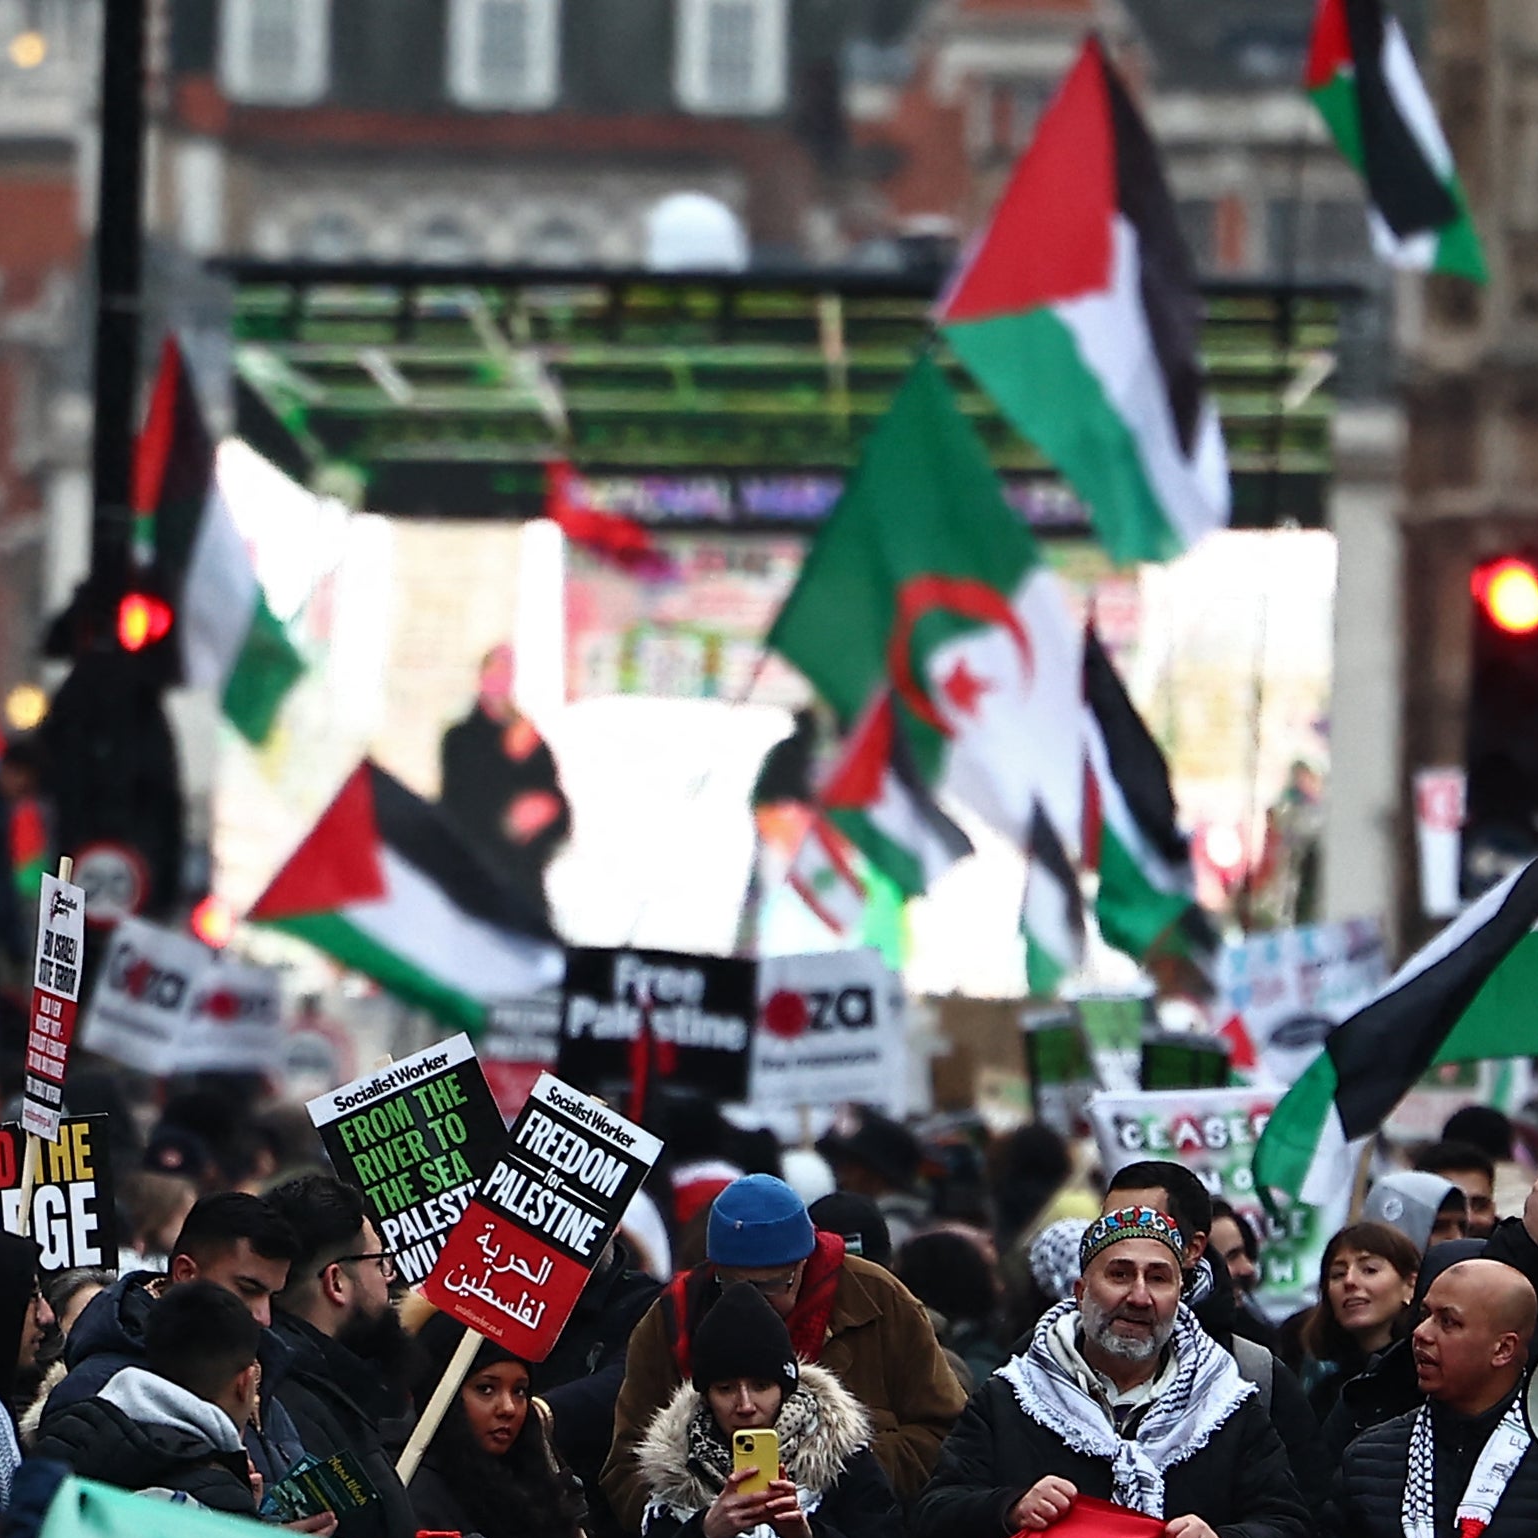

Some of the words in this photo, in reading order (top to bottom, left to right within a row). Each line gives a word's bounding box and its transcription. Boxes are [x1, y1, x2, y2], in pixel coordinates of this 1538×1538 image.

[333, 1074, 396, 1112] Socialist
[394, 1052, 449, 1086] Worker
[338, 1096, 415, 1154] FROM
[413, 1073, 468, 1119] THE
[352, 1130, 431, 1186] RIVER
[427, 1113, 468, 1150] TO
[546, 1086, 593, 1125] Socialist
[588, 1110, 637, 1149] Worker
[365, 1172, 421, 1217] THE
[420, 1150, 473, 1194] SEA
[516, 1109, 629, 1199] FREEDOM
[543, 1166, 565, 1191] for
[482, 1161, 606, 1256] PALESTINE
[476, 1222, 554, 1287] الحرية
[443, 1264, 547, 1330] لفلسطين
